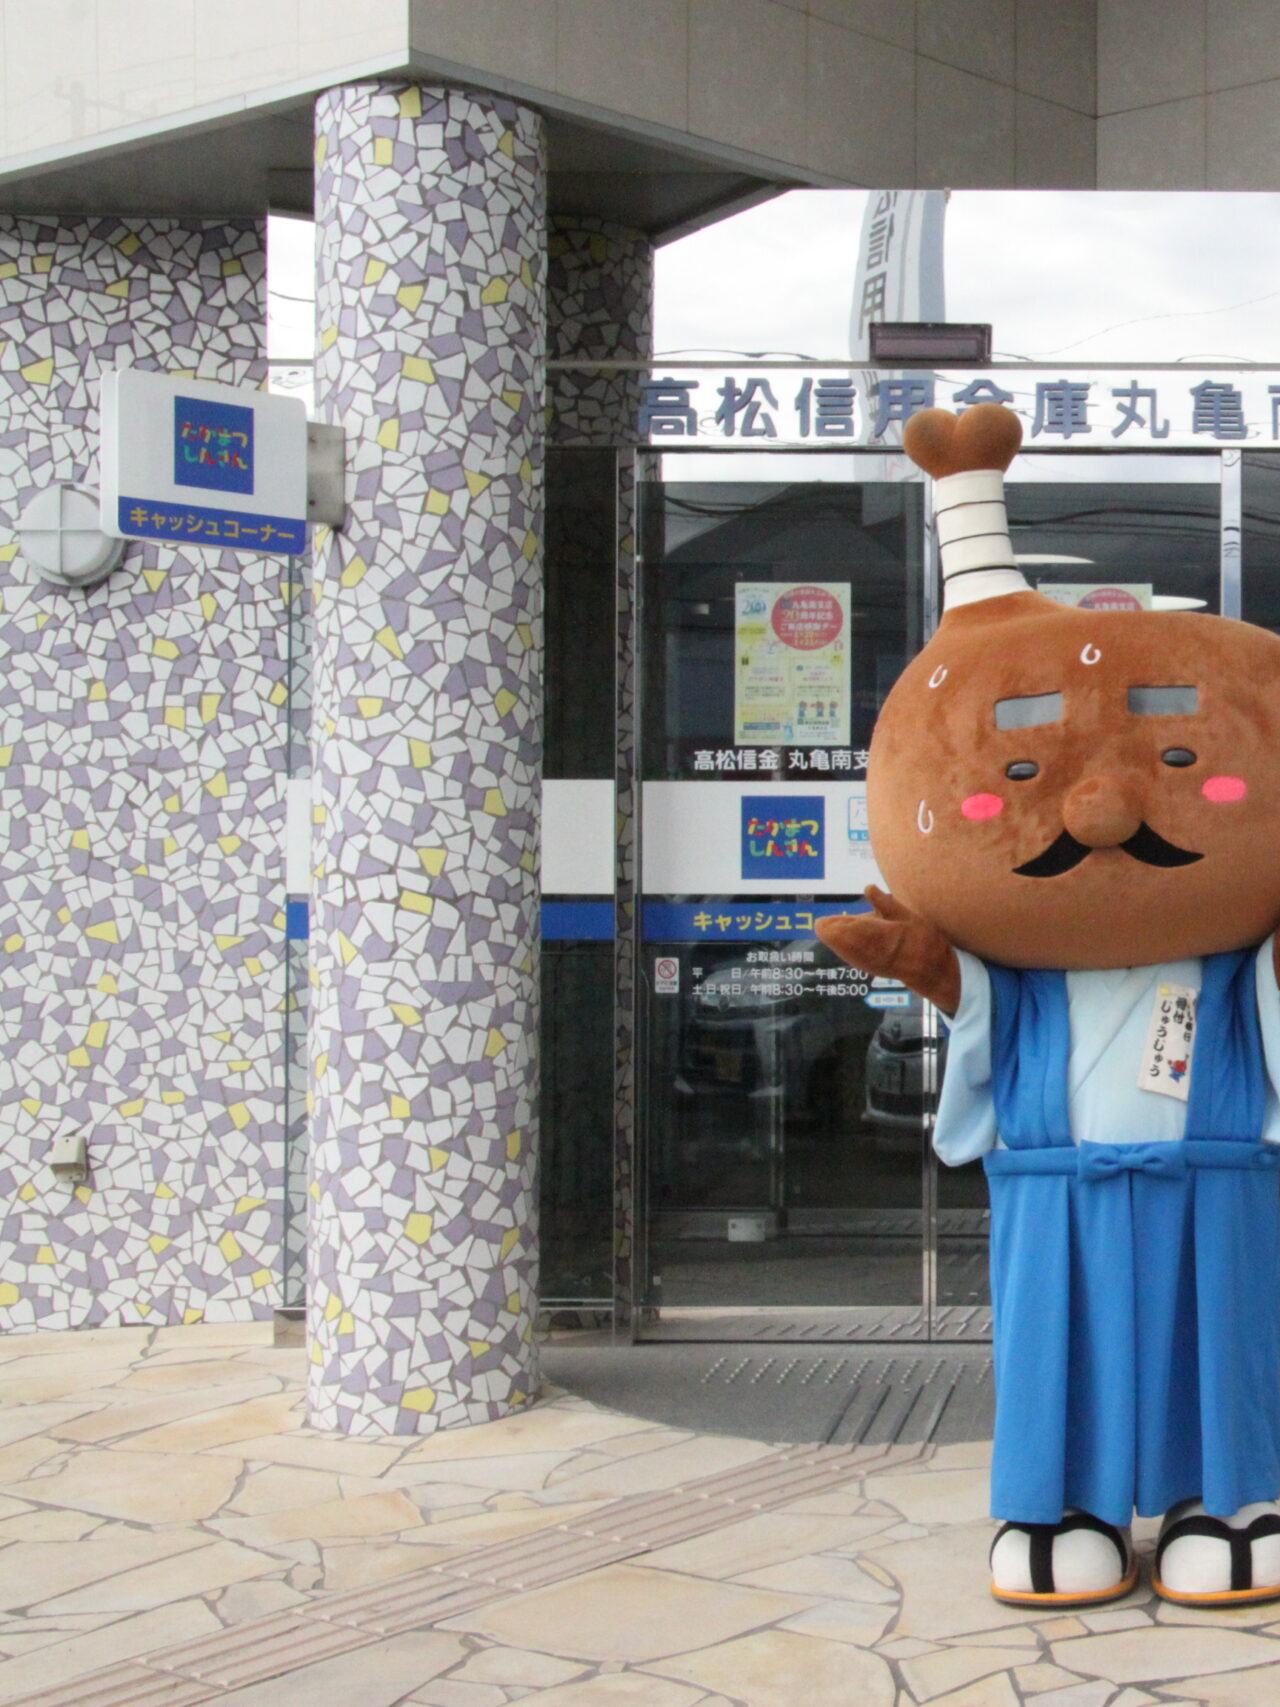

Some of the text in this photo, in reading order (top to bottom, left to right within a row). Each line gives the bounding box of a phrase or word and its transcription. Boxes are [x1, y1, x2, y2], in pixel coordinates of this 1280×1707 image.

[181, 421, 248, 448] たかまつ
[184, 445, 248, 470] しんきん
[130, 507, 295, 542] キャッシュコーナー
[694, 749, 780, 771] 高松信金
[747, 818, 818, 837] たかまつ
[750, 840, 818, 857] しんきん
[746, 951, 815, 963] お取扱い時間
[1150, 1000, 1173, 1077] じゅうじゅう
